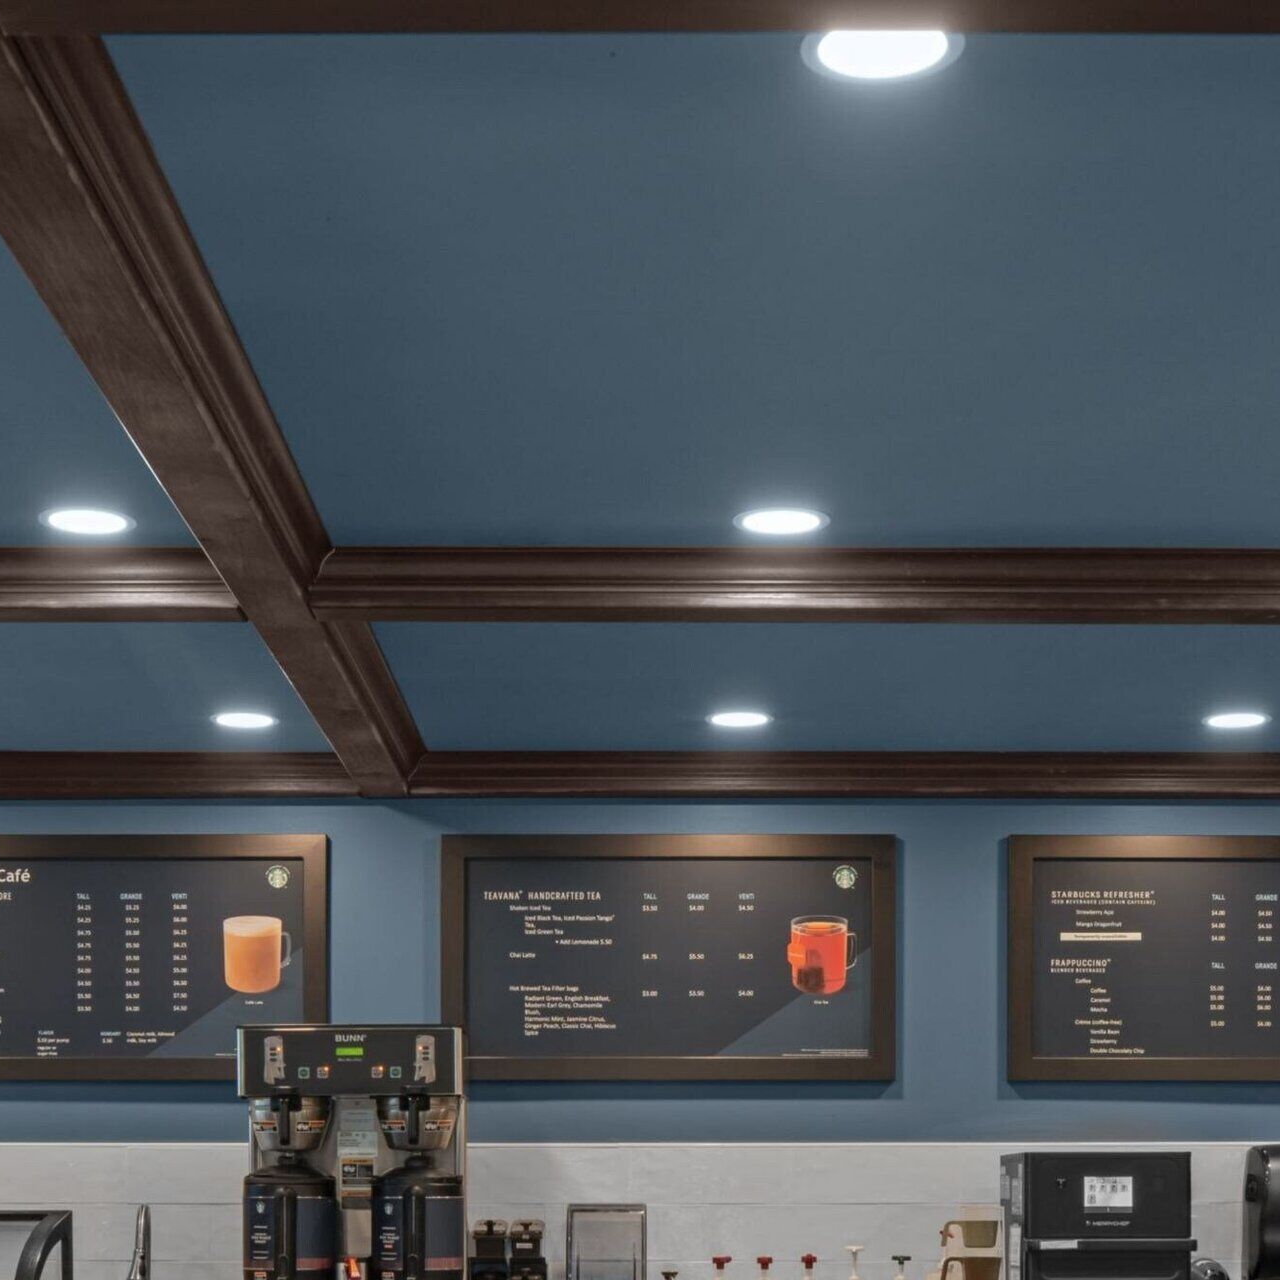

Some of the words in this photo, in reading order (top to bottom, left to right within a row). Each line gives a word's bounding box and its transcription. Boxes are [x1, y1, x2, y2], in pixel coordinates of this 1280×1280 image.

[643, 892, 657, 900] TALL
[1051, 890, 1101, 899] STARBUCKS
[1211, 893, 1226, 901] TALL
